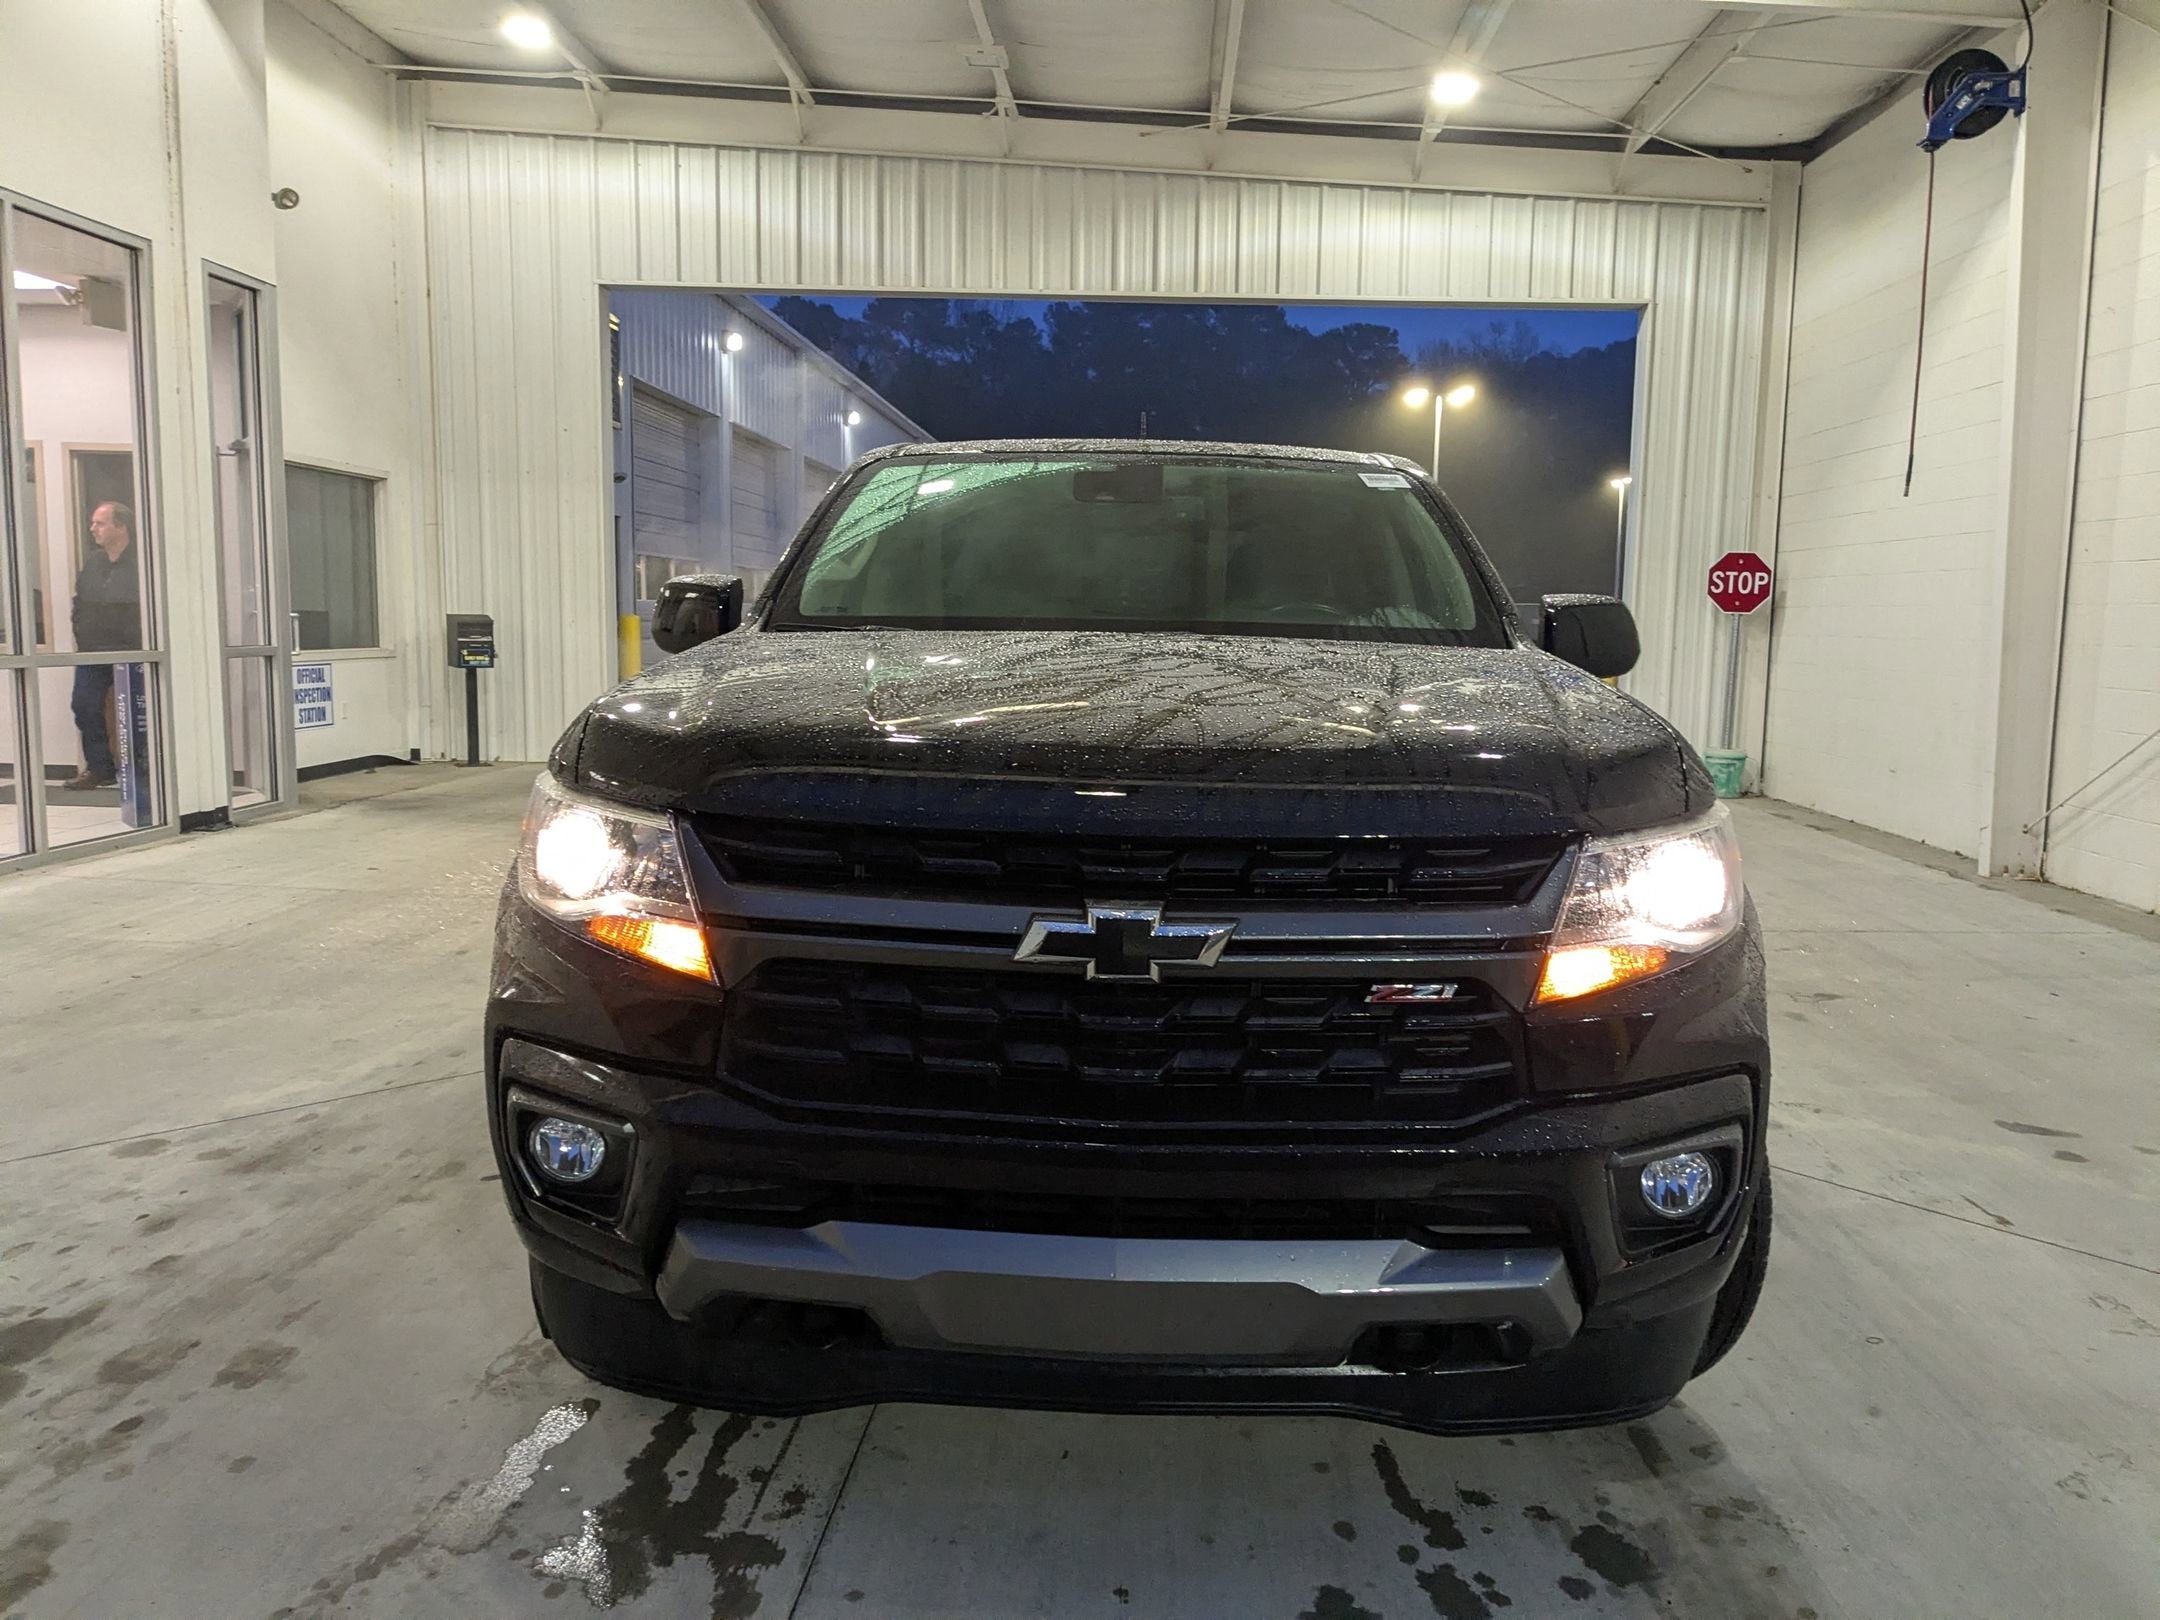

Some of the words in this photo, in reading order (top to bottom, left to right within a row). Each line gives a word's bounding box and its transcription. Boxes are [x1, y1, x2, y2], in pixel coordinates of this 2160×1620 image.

[1710, 570, 1769, 595] STOP
[296, 667, 325, 685] OFFICIAL
[293, 686, 332, 705] NSPECTION
[298, 706, 327, 725] STATION
[1364, 984, 1459, 1003] Z71
